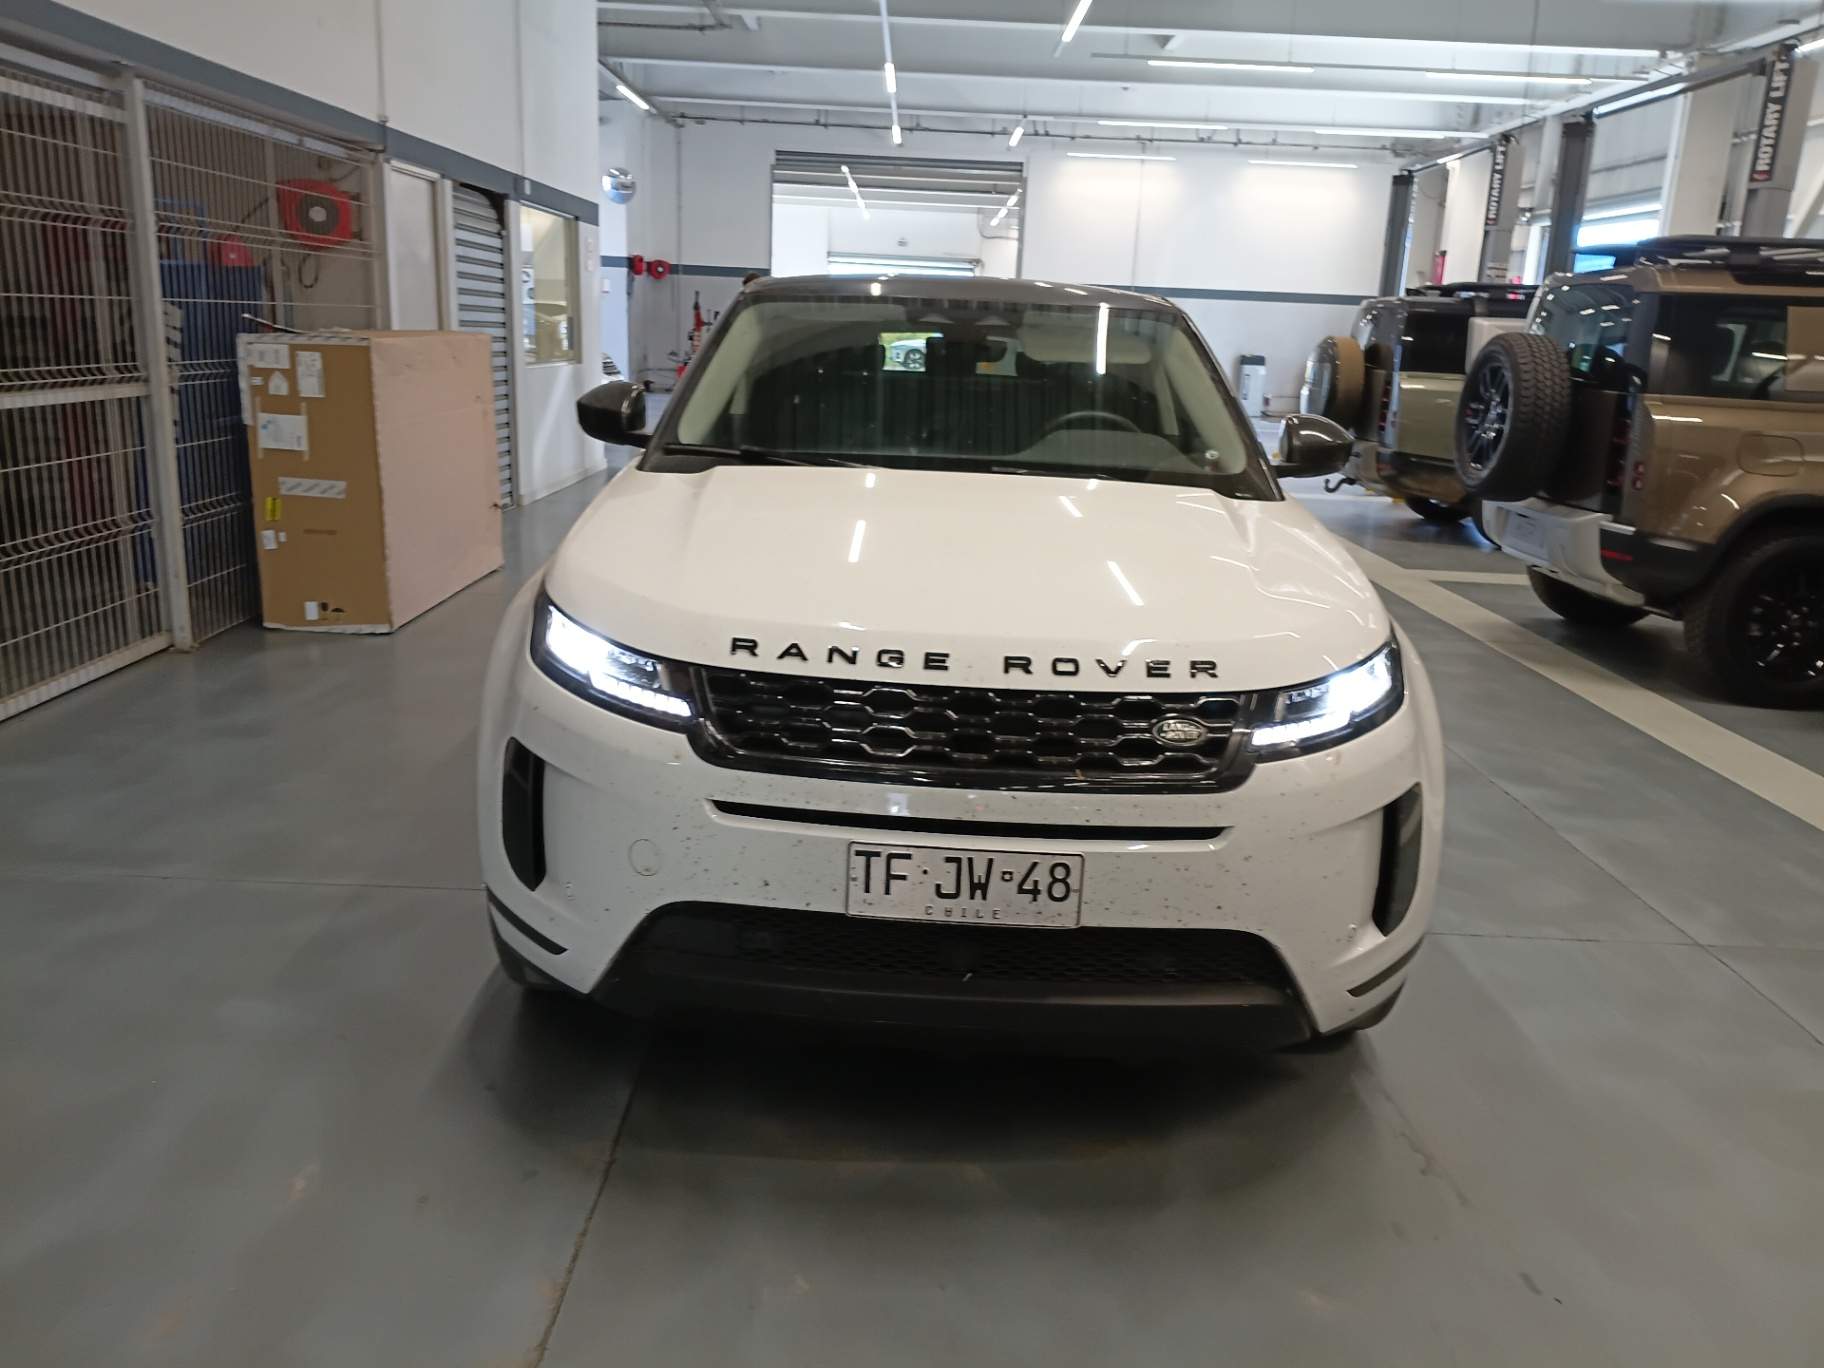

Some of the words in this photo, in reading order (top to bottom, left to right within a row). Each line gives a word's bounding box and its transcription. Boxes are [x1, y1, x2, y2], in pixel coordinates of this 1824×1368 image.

[1768, 61, 1790, 98] LIFT
[1755, 102, 1783, 171] ROTARY
[729, 636, 951, 673] RANGE
[1002, 655, 1219, 679] ROVER
[924, 904, 1001, 920] CHILE
